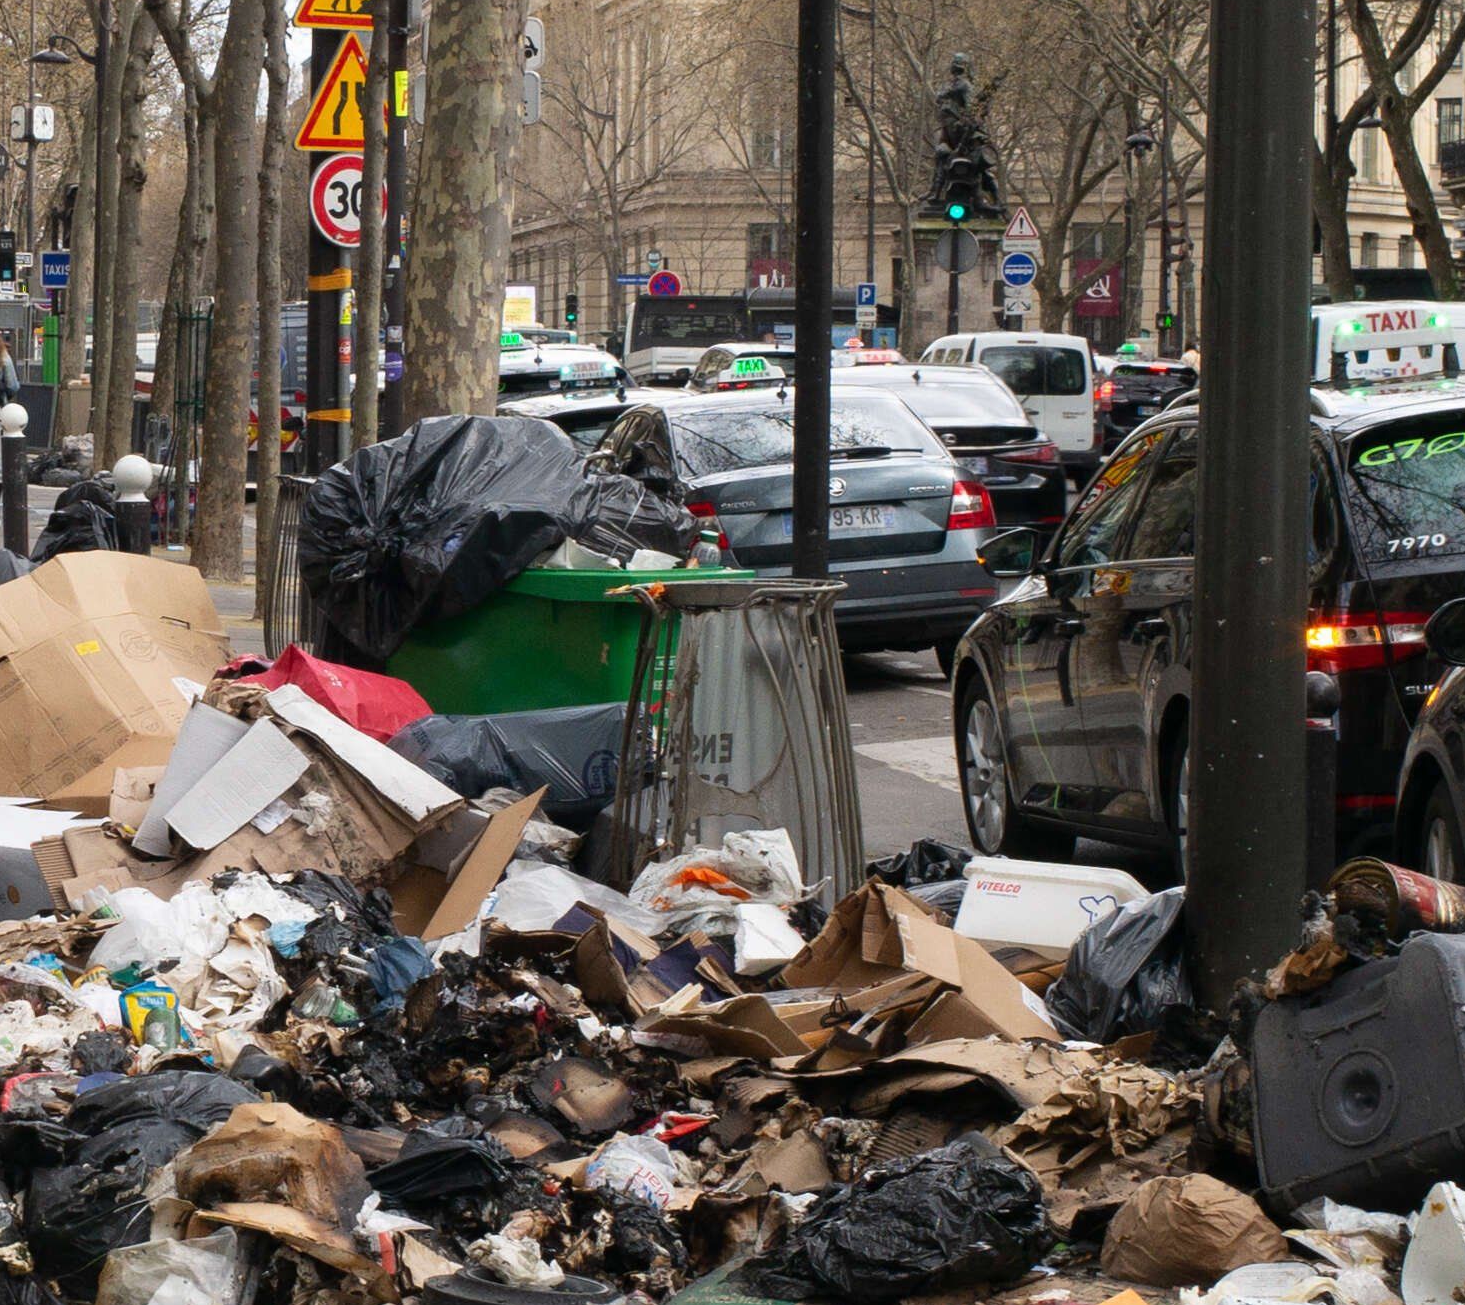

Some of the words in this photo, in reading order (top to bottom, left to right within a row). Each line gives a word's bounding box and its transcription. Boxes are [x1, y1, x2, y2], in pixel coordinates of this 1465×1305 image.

[1366, 310, 1417, 334] TAXI
[735, 358, 766, 375] TAXI
[1387, 533, 1447, 553] 7970
